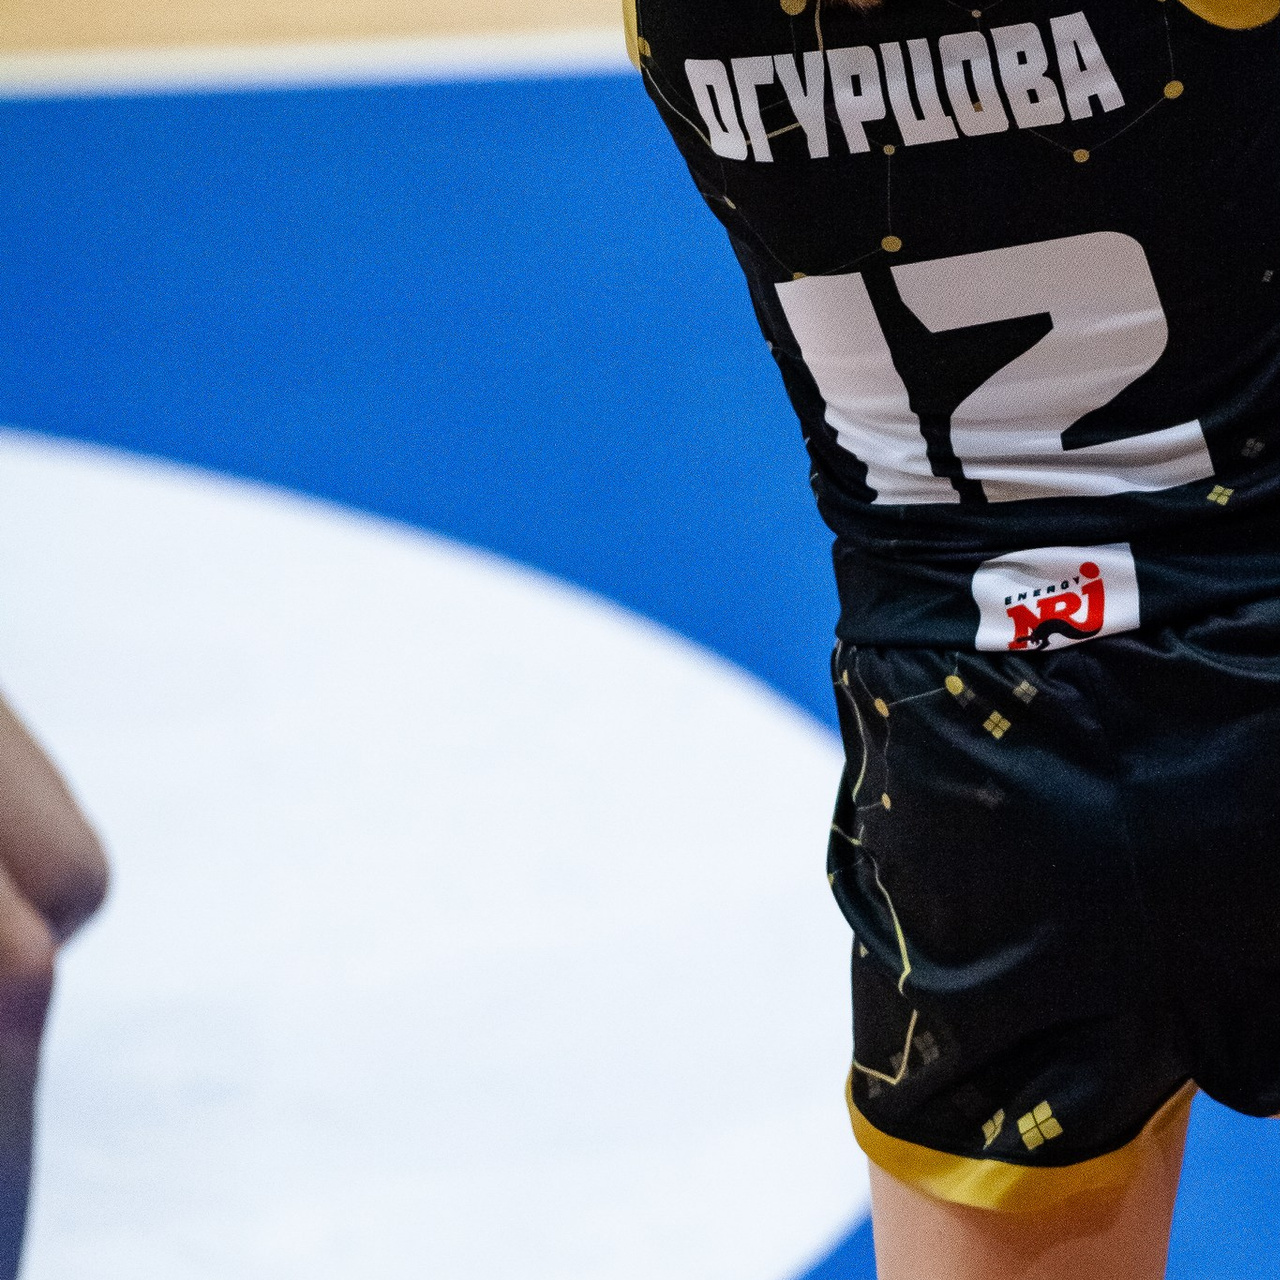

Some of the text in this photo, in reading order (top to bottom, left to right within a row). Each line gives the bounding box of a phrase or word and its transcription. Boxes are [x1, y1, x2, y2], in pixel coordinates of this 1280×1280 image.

[685, 11, 1126, 163] ОГУРЦОВА
[774, 231, 1216, 505] 12
[1004, 576, 1080, 605] ENERGY
